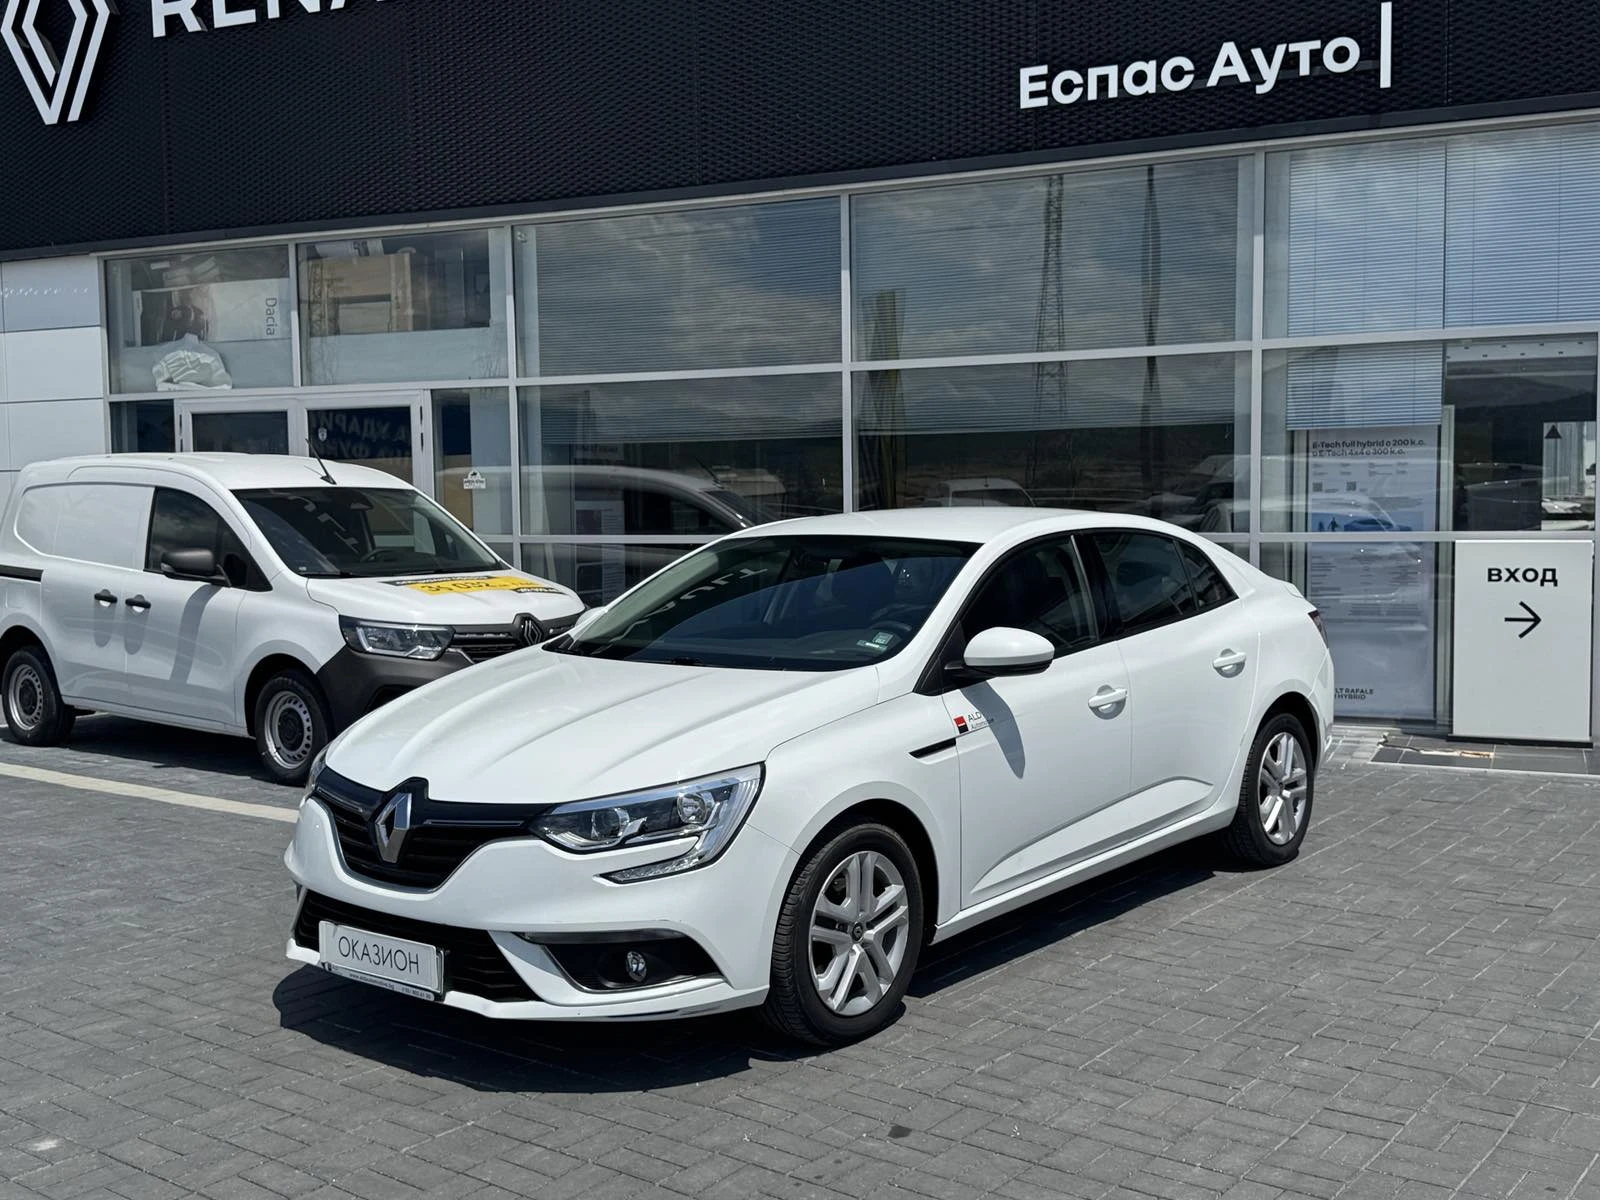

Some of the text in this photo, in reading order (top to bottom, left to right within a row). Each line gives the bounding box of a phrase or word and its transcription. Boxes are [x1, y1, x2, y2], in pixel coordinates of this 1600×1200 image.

[1019, 36, 1361, 109] Еспас Ауто
[265, 297, 278, 336] Dacia
[1342, 440, 1356, 448] full
[1357, 439, 1385, 448] hybrid
[1345, 687, 1374, 695] RAFALE
[967, 711, 982, 722] ALD
[338, 936, 420, 975] ОКАЗИОН
